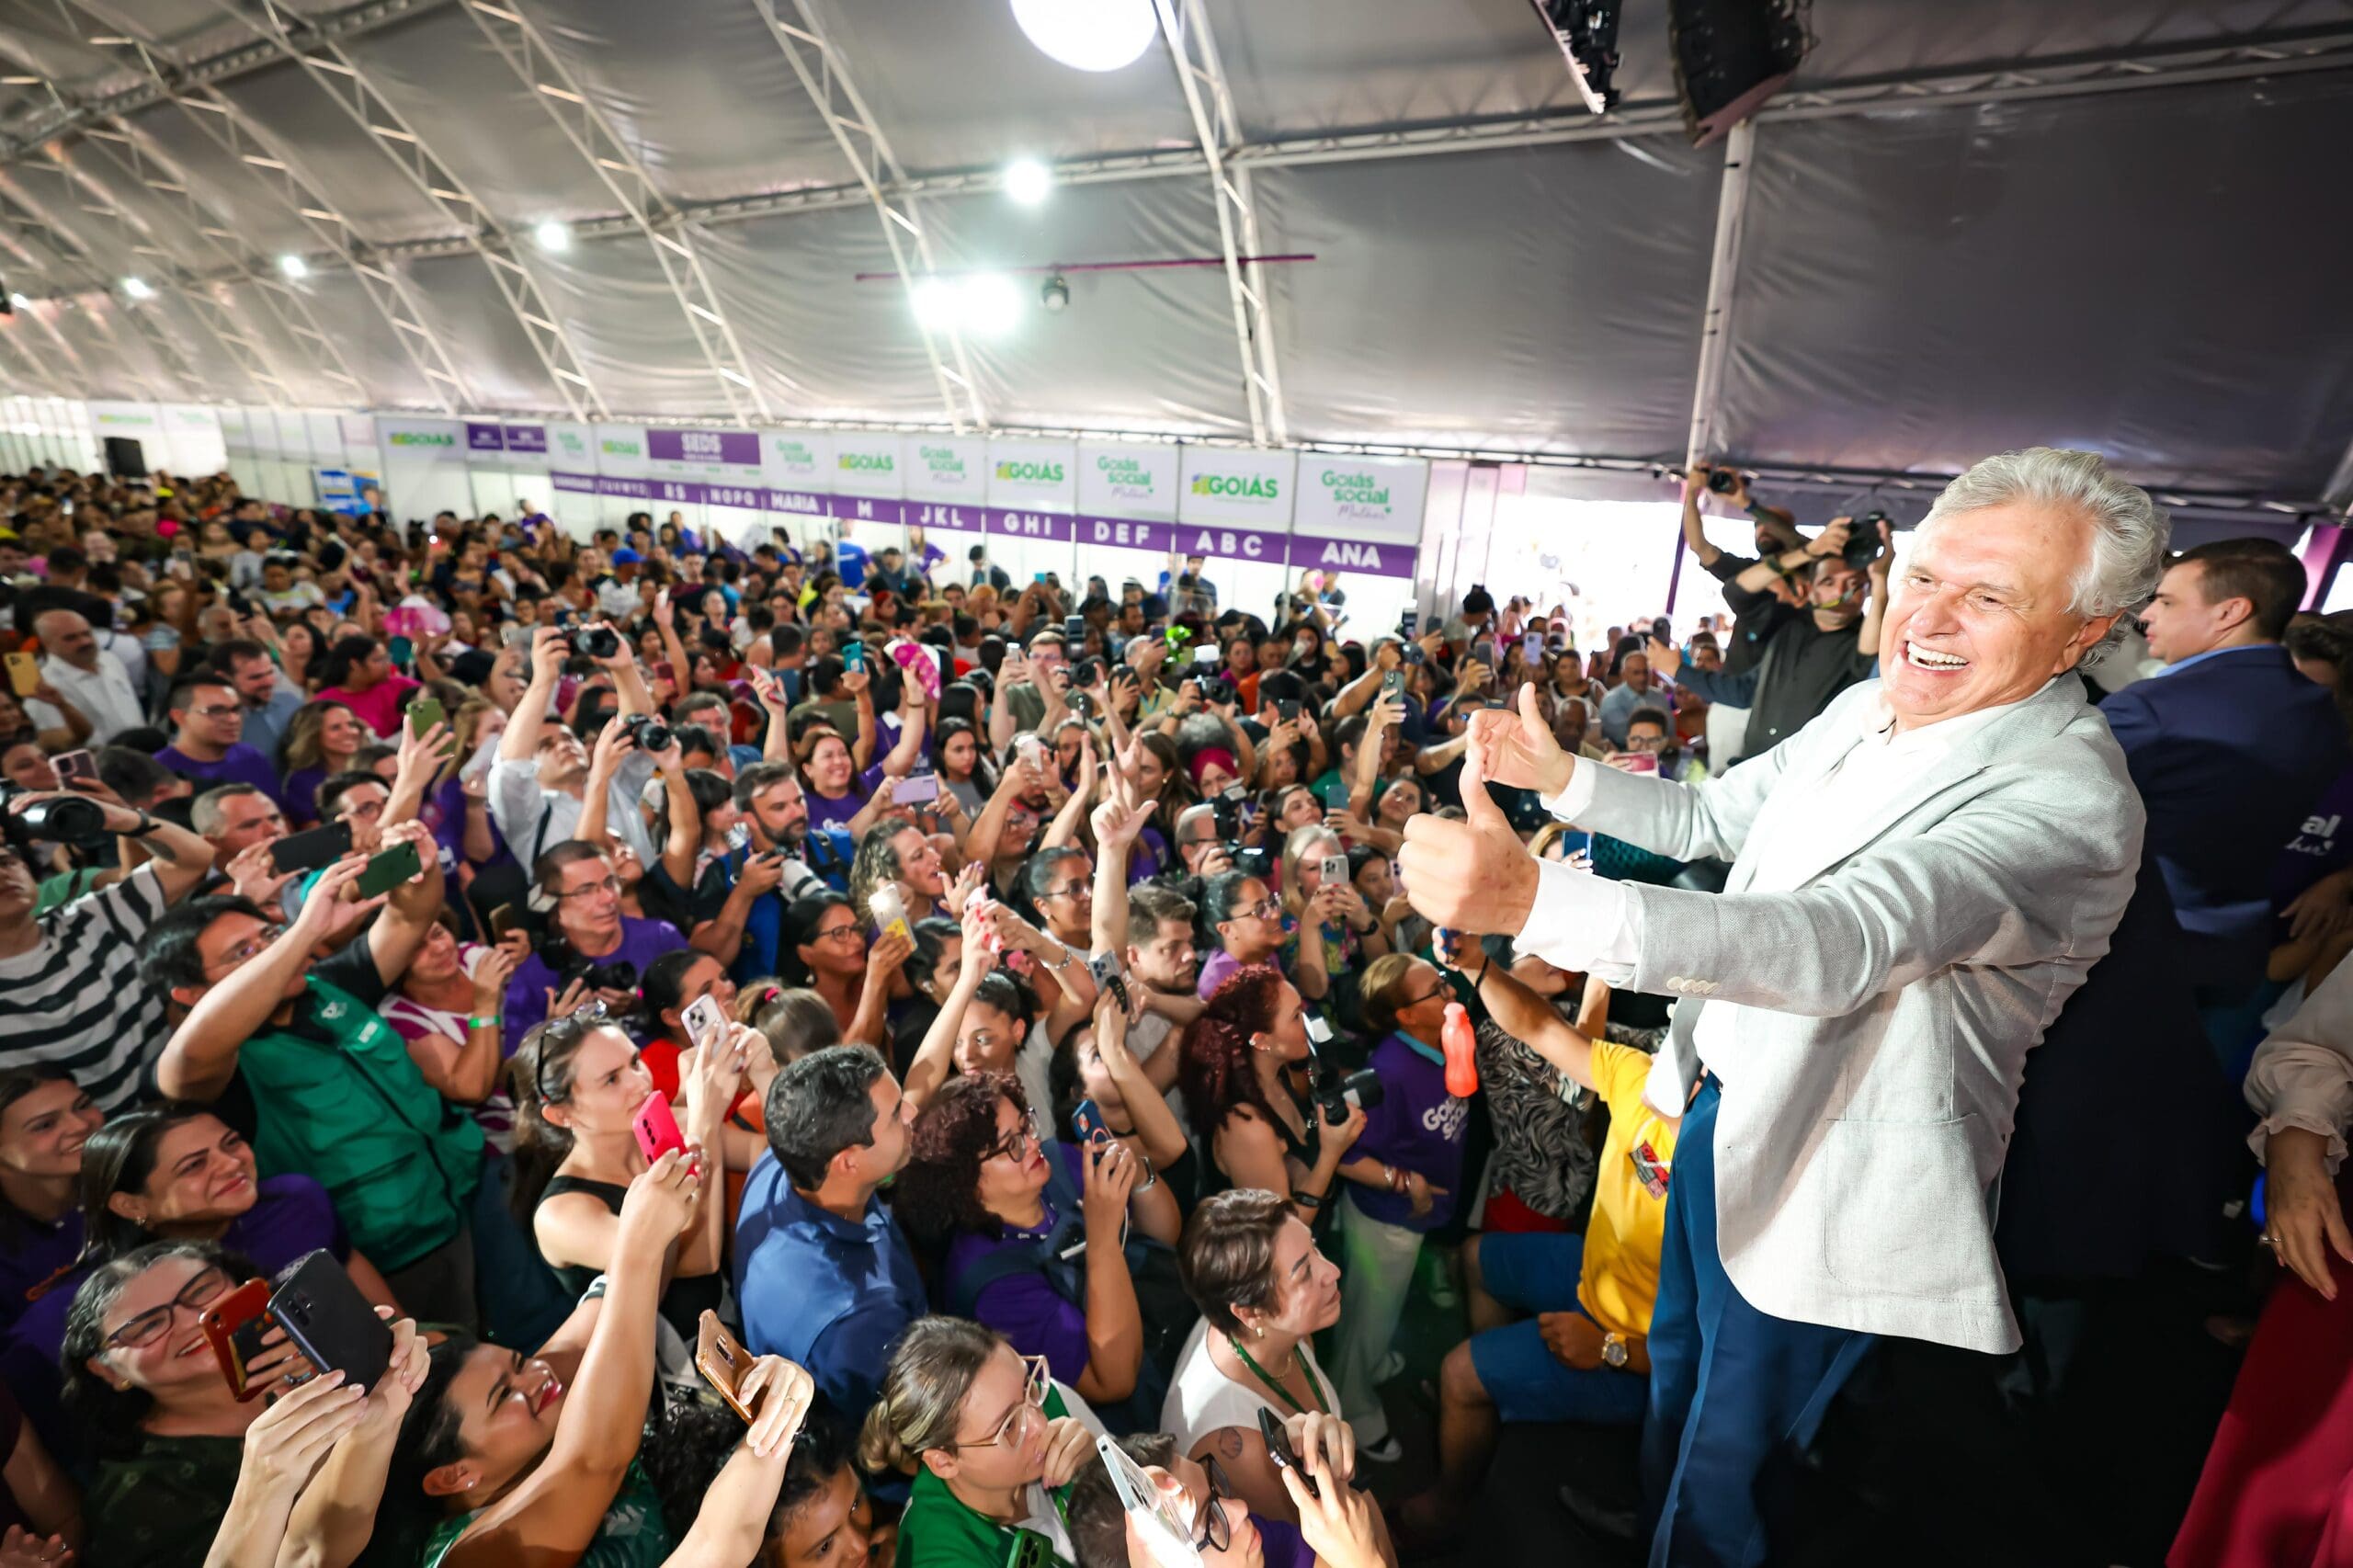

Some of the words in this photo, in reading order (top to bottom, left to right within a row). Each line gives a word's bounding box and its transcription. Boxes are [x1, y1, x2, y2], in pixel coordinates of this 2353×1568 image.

[848, 450, 894, 472] GOIÁS
[1008, 460, 1064, 482] GOIÁS
[1097, 455, 1140, 472] Goiás
[1107, 469, 1152, 486] social
[1208, 472, 1279, 499] GOIÁS
[1322, 470, 1375, 489] Goiás
[770, 491, 820, 513] MARIA
[1334, 486, 1390, 506] social
[857, 501, 873, 517] M
[1320, 541, 1382, 570] ANA
